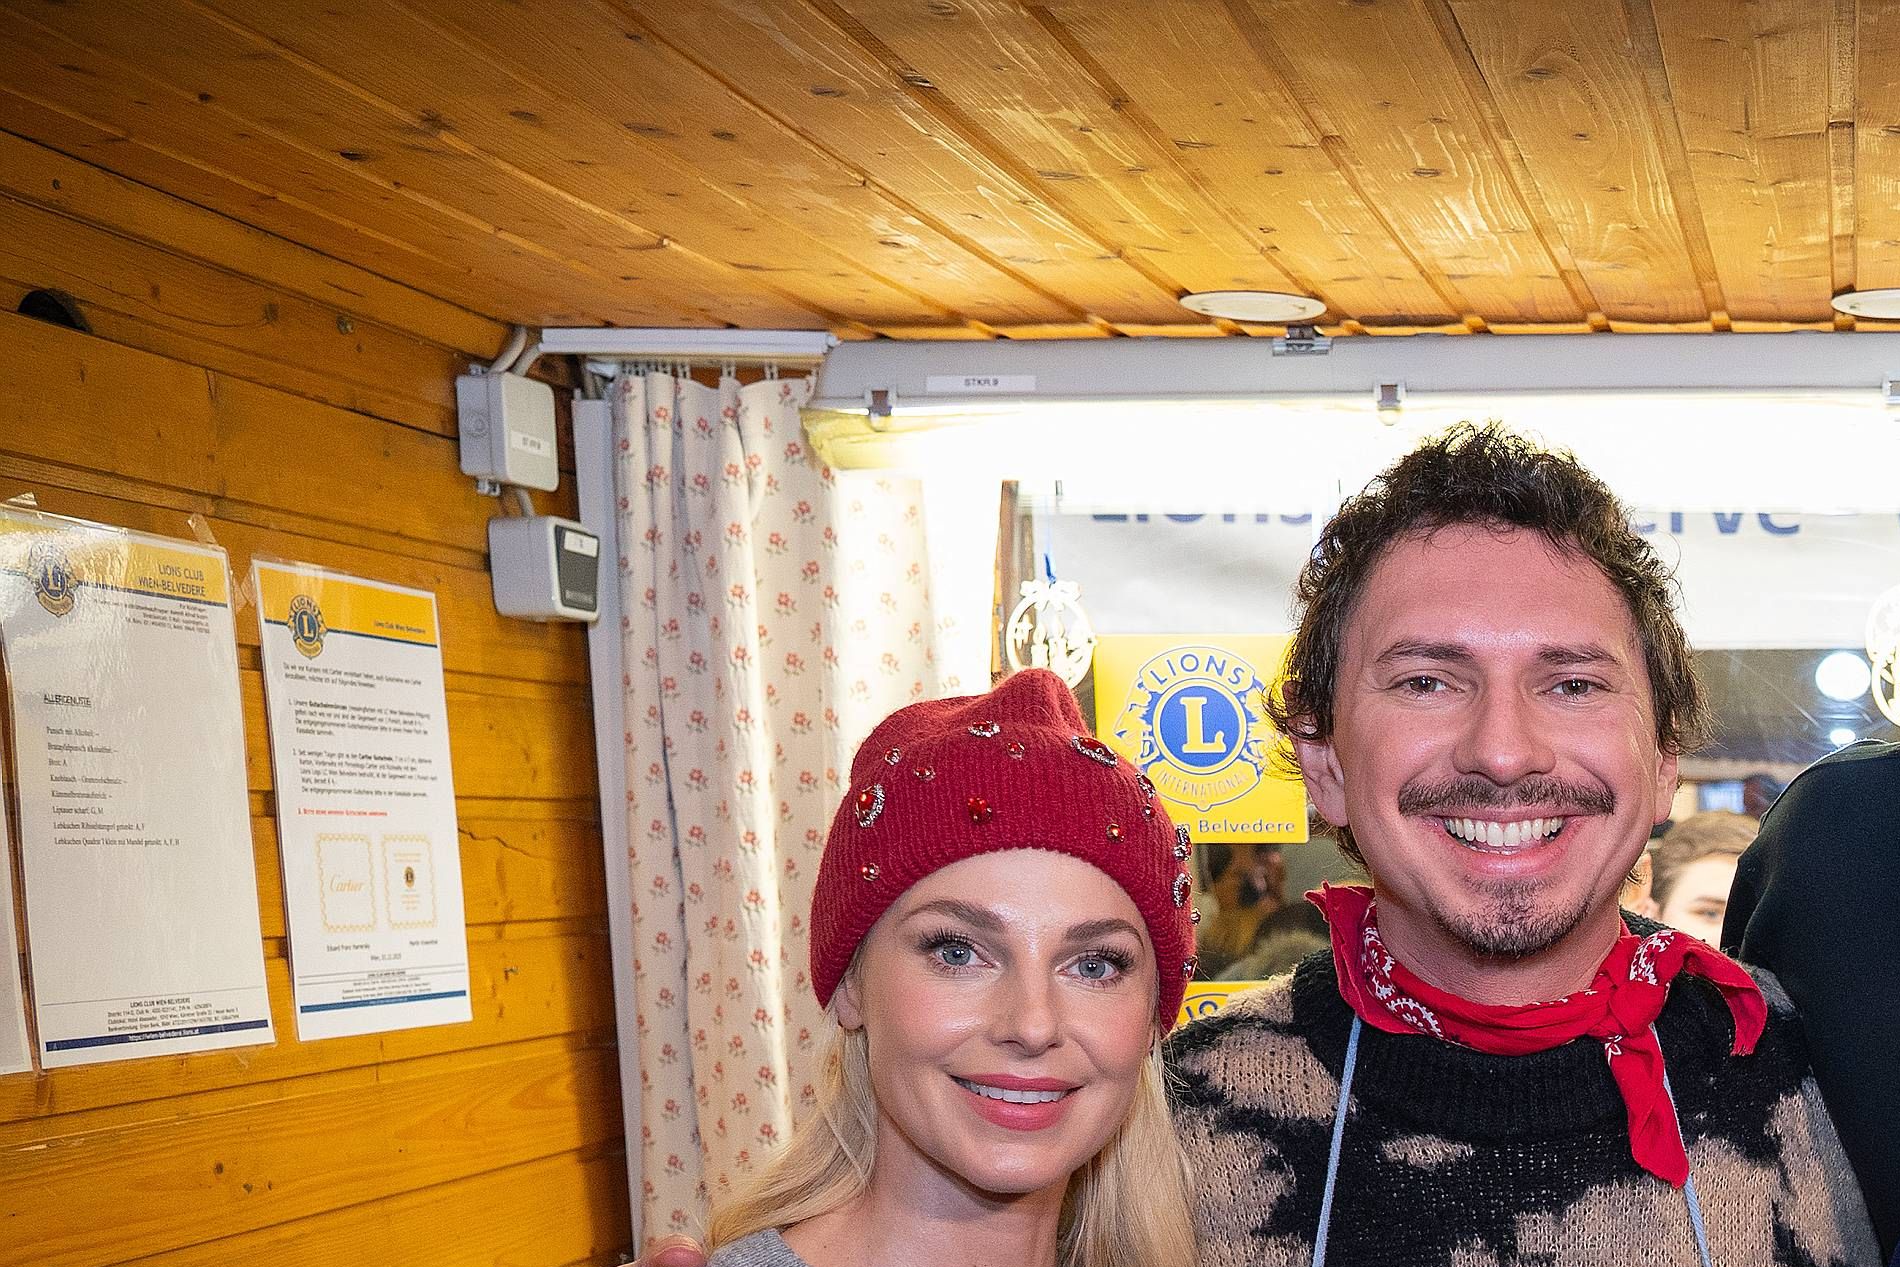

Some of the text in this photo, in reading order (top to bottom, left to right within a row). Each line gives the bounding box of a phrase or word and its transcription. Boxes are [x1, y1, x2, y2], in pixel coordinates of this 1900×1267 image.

[159, 564, 205, 582] LIONS CLUB
[139, 576, 206, 597] WIEN-BELVEDERE
[303, 615, 314, 638] L
[1150, 653, 1245, 686] LIONS
[1180, 696, 1227, 754] L
[1155, 768, 1249, 798] INTERNATIONAL
[1199, 819, 1295, 834] Belvedere
[330, 874, 364, 894] Cartier
